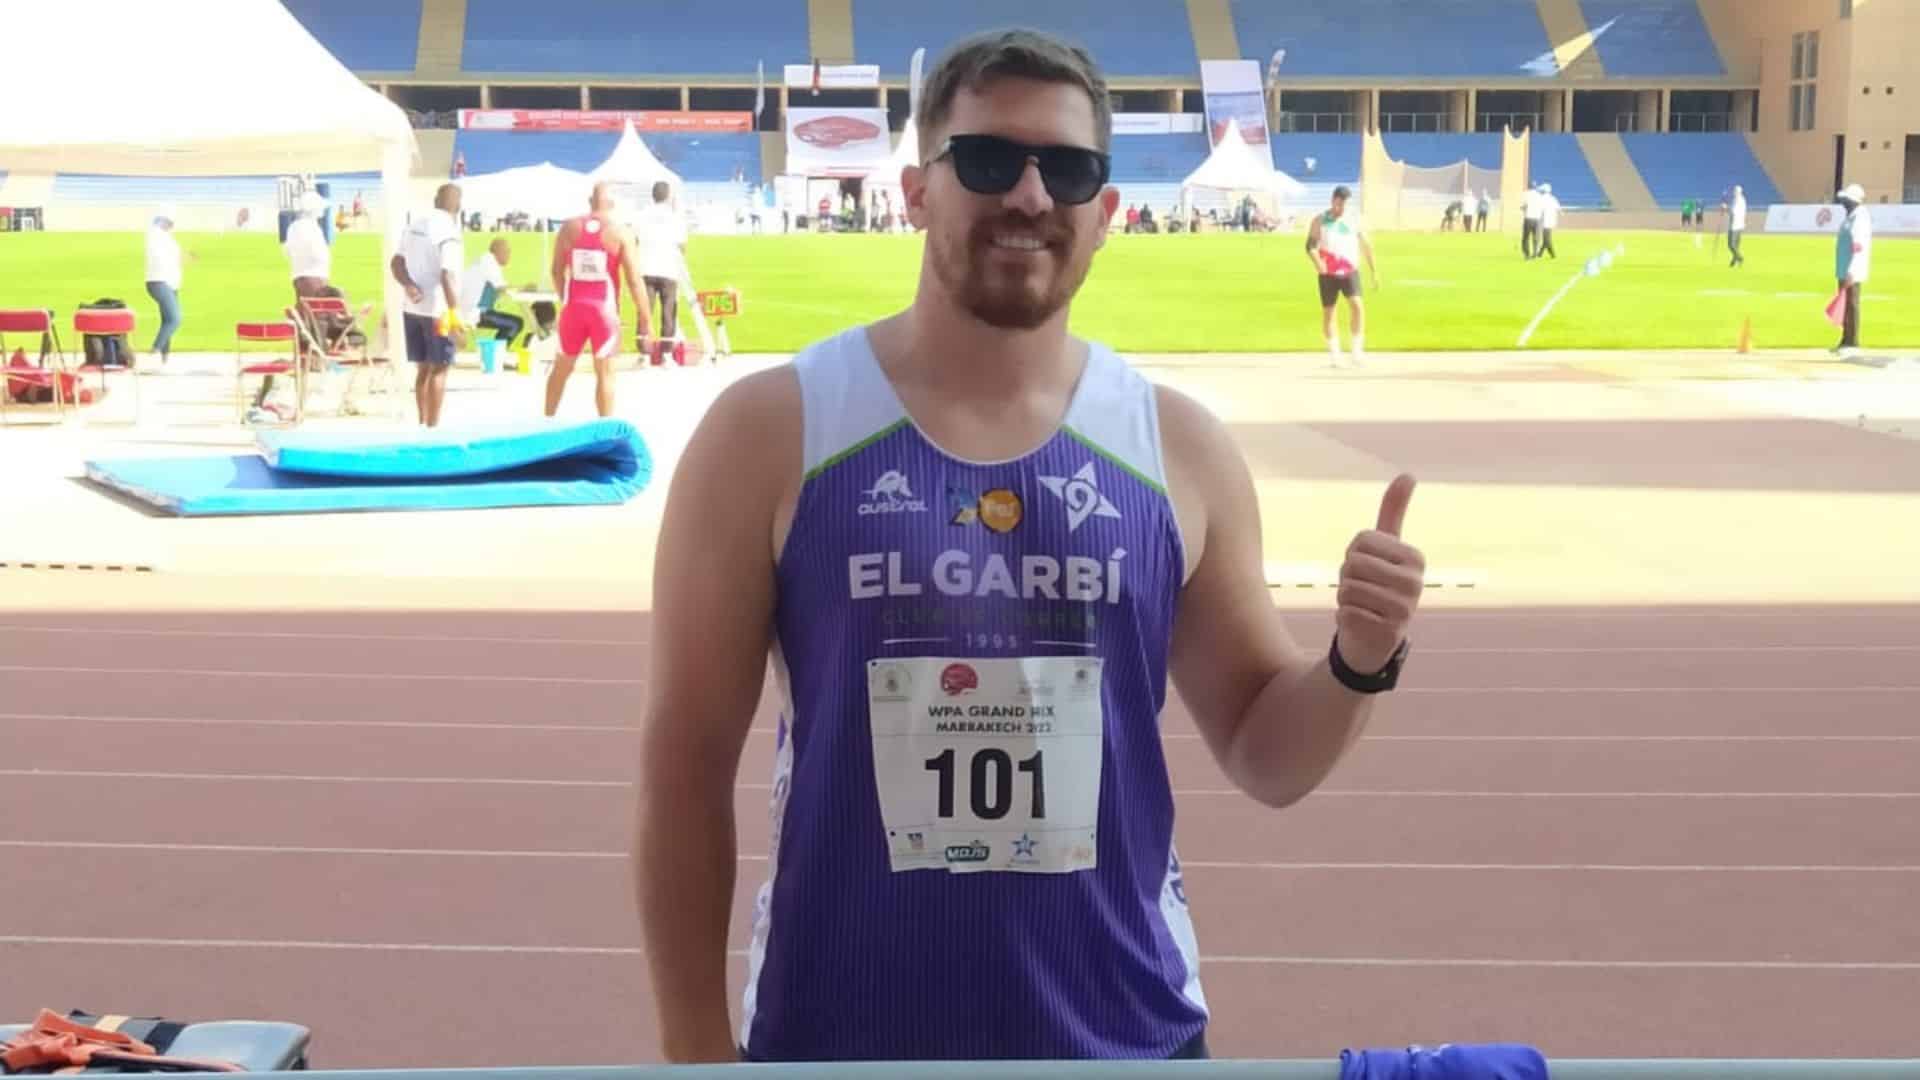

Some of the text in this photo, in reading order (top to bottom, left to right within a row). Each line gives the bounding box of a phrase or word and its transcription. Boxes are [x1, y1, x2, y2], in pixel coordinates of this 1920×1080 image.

[848, 547, 1128, 605] EL GARBÍ
[965, 632, 1018, 649] 1995
[928, 705, 963, 718] WPA
[968, 704, 1025, 718] GRAND
[935, 721, 1022, 734] MARRAKECH
[924, 748, 1046, 820] 101
